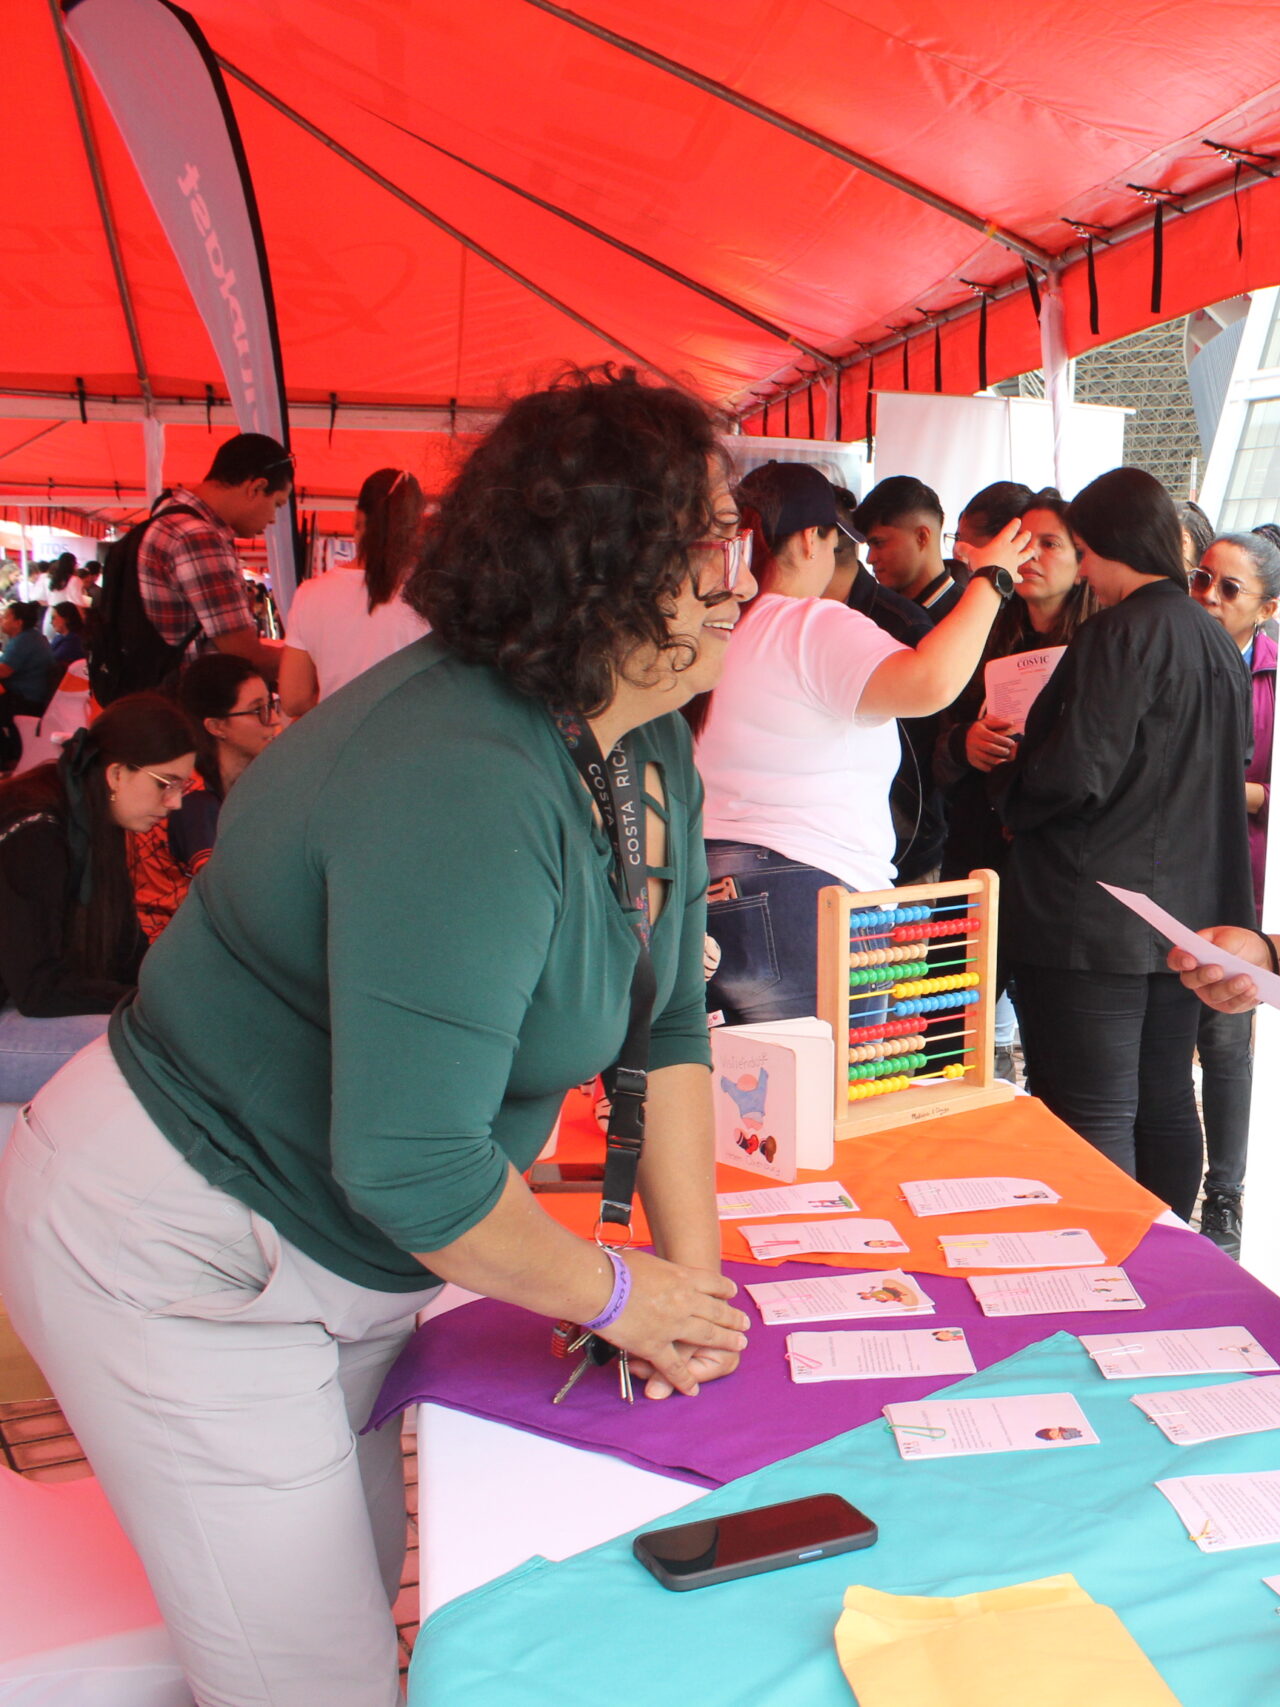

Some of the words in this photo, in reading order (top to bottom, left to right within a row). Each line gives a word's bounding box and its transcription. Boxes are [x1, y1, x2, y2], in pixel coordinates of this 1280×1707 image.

[1016, 655, 1050, 668] COSVIC
[612, 740, 631, 788] RICA
[588, 763, 614, 827] COSTA
[621, 800, 641, 866] COSTA
